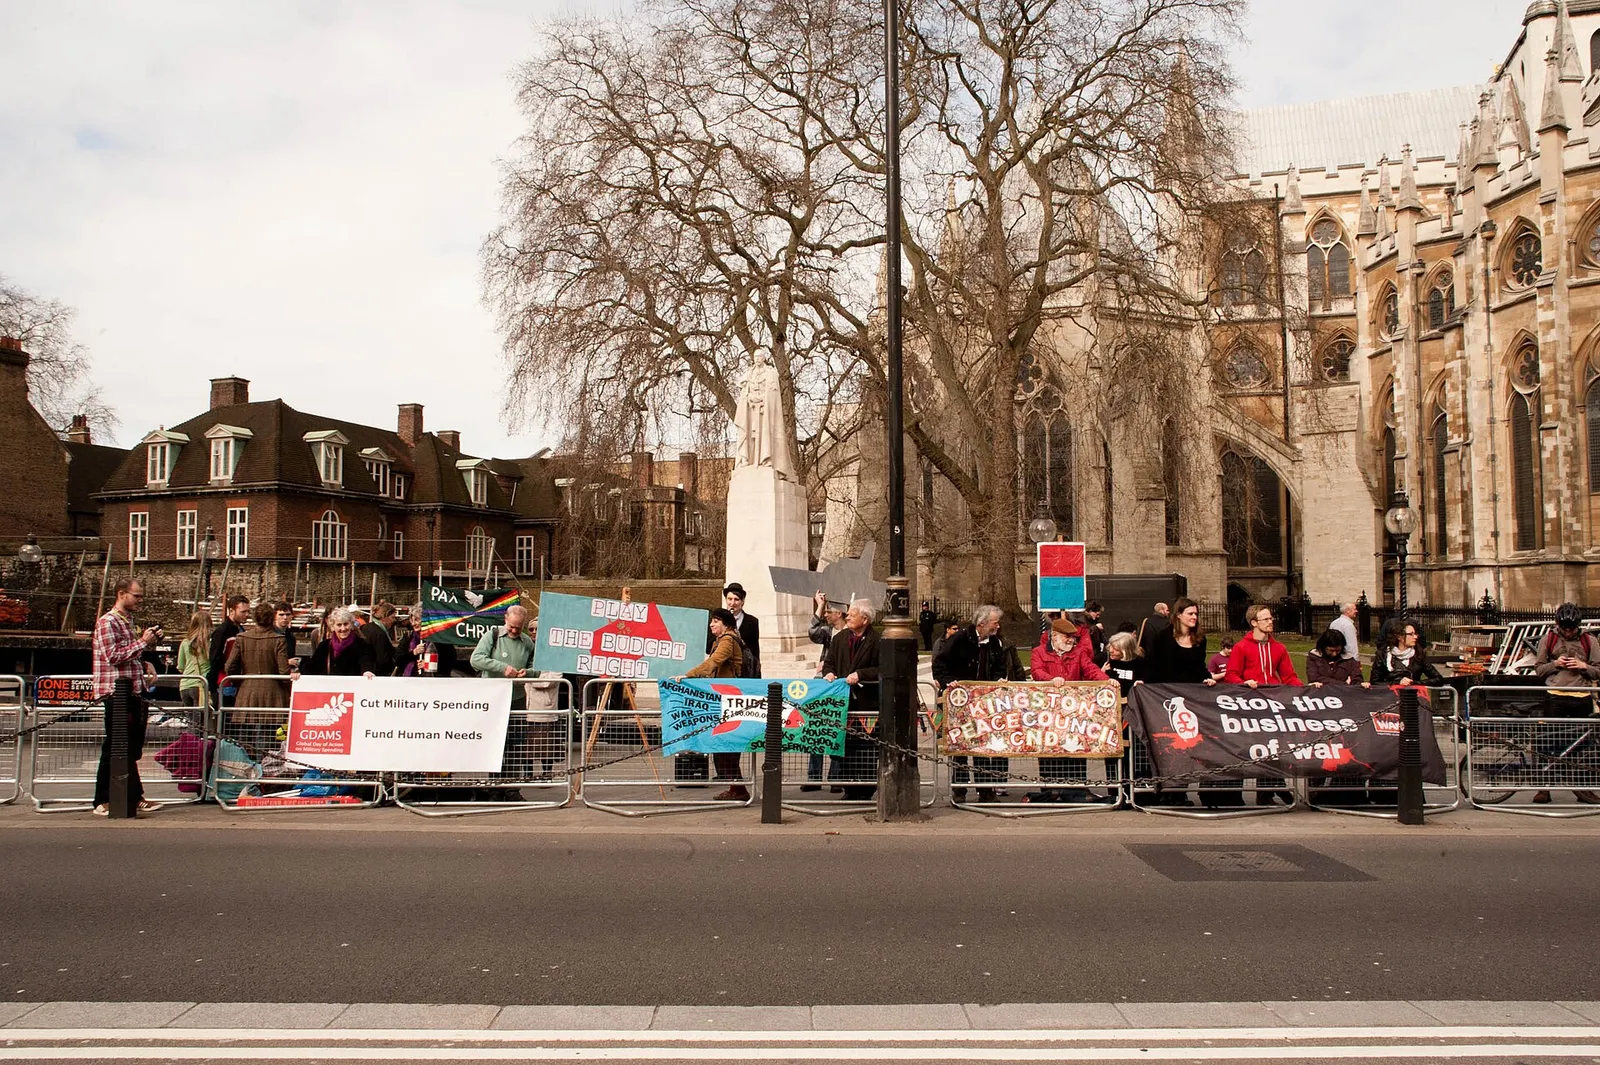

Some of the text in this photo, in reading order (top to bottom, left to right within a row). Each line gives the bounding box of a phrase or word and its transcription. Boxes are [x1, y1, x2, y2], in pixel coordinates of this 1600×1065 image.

[592, 600, 647, 620] PLAY
[551, 628, 686, 659] THE BUDGET
[578, 655, 649, 677] RIGHT
[660, 681, 722, 702] AFGHANISTAN
[360, 698, 490, 711] Cut Military Spending
[683, 697, 709, 711] IRAQ
[969, 691, 1096, 717] KINGSTON
[1216, 694, 1343, 713] Stop the
[671, 709, 694, 721] WAR
[672, 714, 720, 731] WEAPONS
[1220, 713, 1359, 734] business
[300, 729, 342, 741] GDAMS
[365, 729, 483, 740] Fund Human Needs
[802, 727, 838, 739] HOUSES
[1010, 730, 1059, 747] CND
[781, 743, 825, 754] SERVICES
[800, 735, 840, 751] SCHOOLS
[1249, 738, 1343, 761] of war
